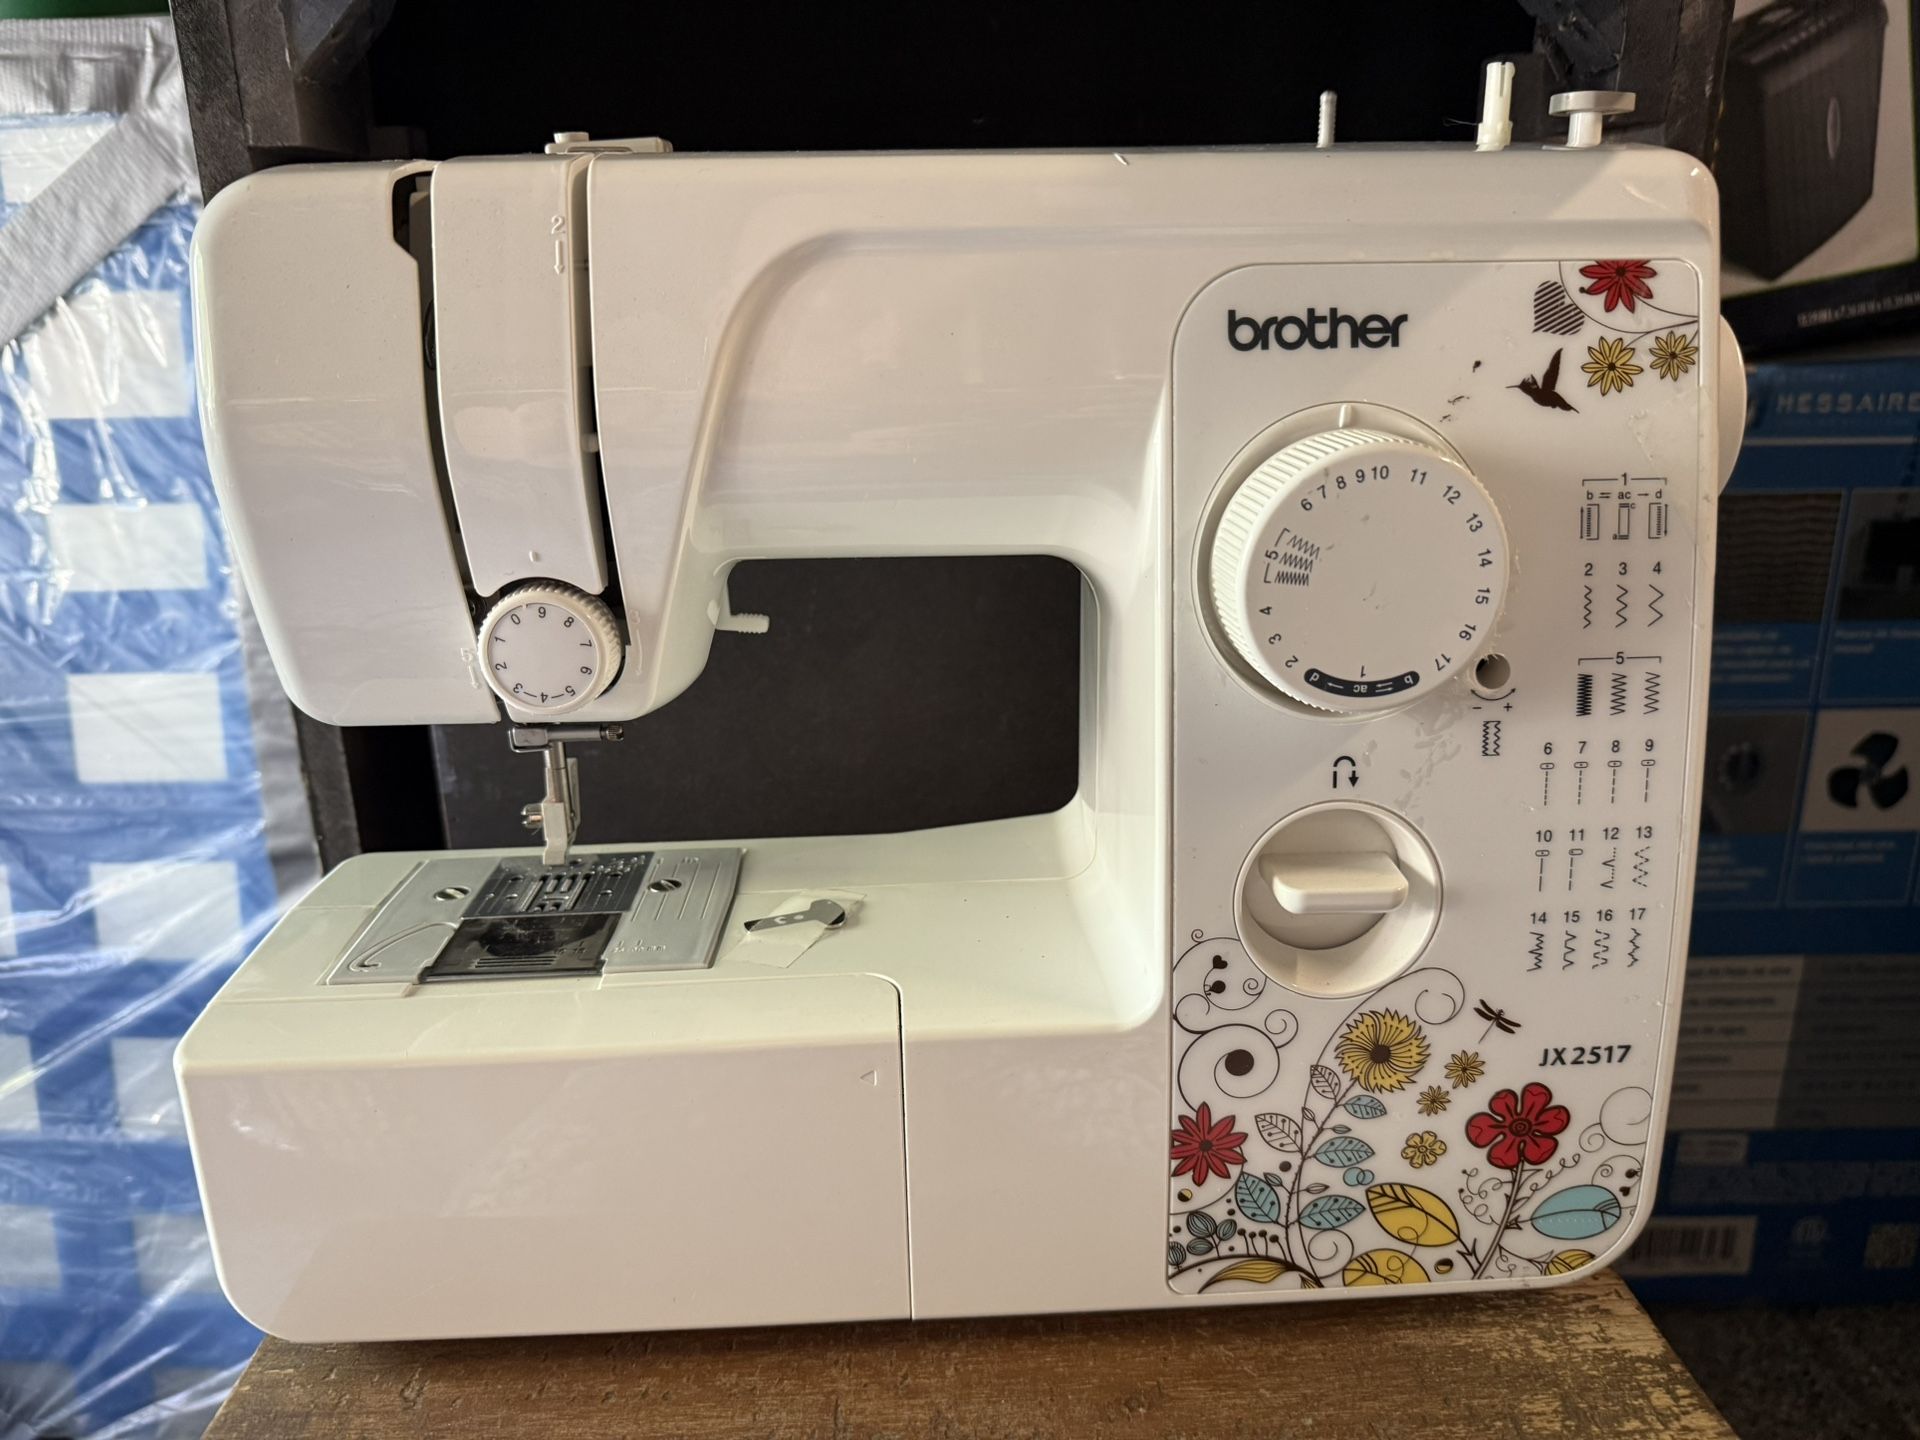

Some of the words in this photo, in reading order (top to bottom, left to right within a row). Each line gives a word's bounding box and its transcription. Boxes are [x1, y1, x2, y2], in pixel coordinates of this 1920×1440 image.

[1227, 307, 1409, 352] brother
[1775, 391, 1920, 414] HESSAIRE
[1355, 468, 1366, 484] 9
[1371, 465, 1390, 480] 10
[1410, 468, 1428, 485] 11
[1621, 472, 1628, 486] 1
[1335, 475, 1347, 490] 8
[1316, 484, 1327, 499] 7
[1442, 485, 1461, 505] 12
[1586, 490, 1594, 501] b
[1617, 491, 1631, 500] ac
[1654, 488, 1663, 500] d
[1300, 498, 1313, 512] 6
[1466, 512, 1483, 533] 13
[1264, 549, 1278, 562] 5
[1478, 548, 1493, 568] 14
[1584, 562, 1594, 577] 2
[1618, 561, 1628, 576] 3
[1652, 561, 1662, 575] 4
[1475, 587, 1491, 605] 15
[537, 606, 547, 619] 9
[1258, 606, 1273, 616] 4
[510, 613, 521, 626] 0
[563, 616, 575, 628] 8
[493, 635, 506, 643] 1
[1268, 633, 1282, 645] 3
[1458, 623, 1477, 641] 16
[579, 639, 593, 648] 7
[1284, 655, 1299, 669] 2
[1434, 653, 1451, 672] 17
[1615, 651, 1625, 665] 5
[494, 661, 508, 671] 2
[579, 666, 593, 675] 6
[1360, 665, 1367, 678] 1
[512, 682, 524, 694] 3
[564, 685, 576, 697] 5
[540, 691, 549, 704] 4
[1543, 742, 1553, 756] 6
[1578, 740, 1587, 754] 7
[1611, 739, 1621, 754] 8
[1644, 738, 1655, 752] 9
[1535, 829, 1553, 843] 10
[1569, 828, 1585, 842] 11
[1602, 826, 1620, 841] 12
[1636, 825, 1653, 839] 13
[1530, 911, 1547, 925] 14
[1563, 910, 1581, 923] 15
[1596, 908, 1613, 922] 16
[1629, 907, 1647, 921] 17
[1538, 1044, 1632, 1067] JX2517
